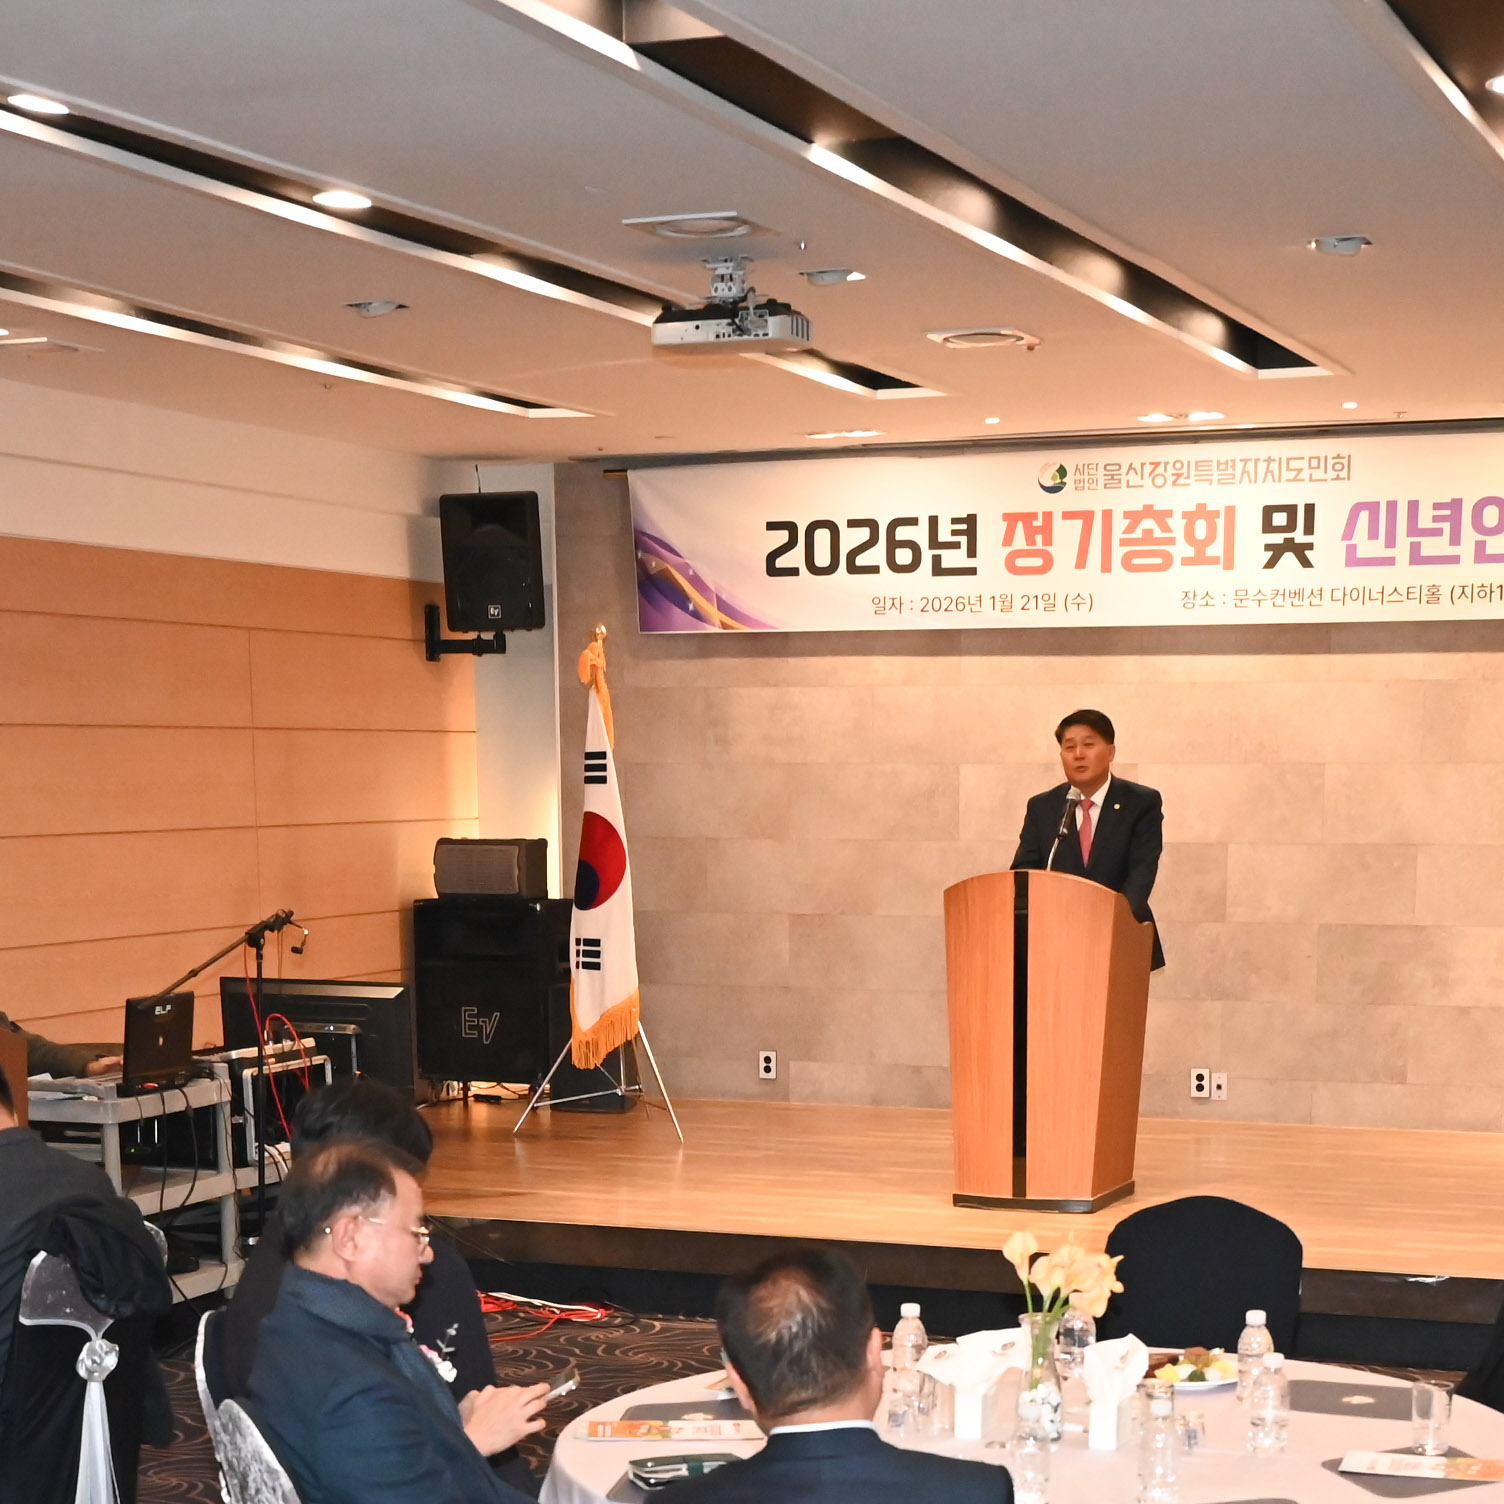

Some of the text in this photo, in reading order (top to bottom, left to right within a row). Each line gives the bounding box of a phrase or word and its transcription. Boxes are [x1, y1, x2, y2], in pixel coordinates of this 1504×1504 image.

[1073, 462, 1099, 477] 사단
[1102, 453, 1352, 489] 울산강원특별자치도민회
[1073, 477, 1099, 491] 법인
[765, 513, 978, 578] 2026년
[1001, 503, 1236, 577] 정기총회
[1261, 502, 1316, 569] 및
[871, 595, 904, 615] 일자
[920, 595, 984, 614] 2026년
[989, 593, 1015, 613] 1월
[1020, 593, 1057, 613] 21일
[1063, 592, 1094, 614] (수)
[1180, 587, 1216, 609] 장소
[1233, 586, 1324, 608] 문수컨벤션
[1330, 582, 1443, 606] 다이너스티홀
